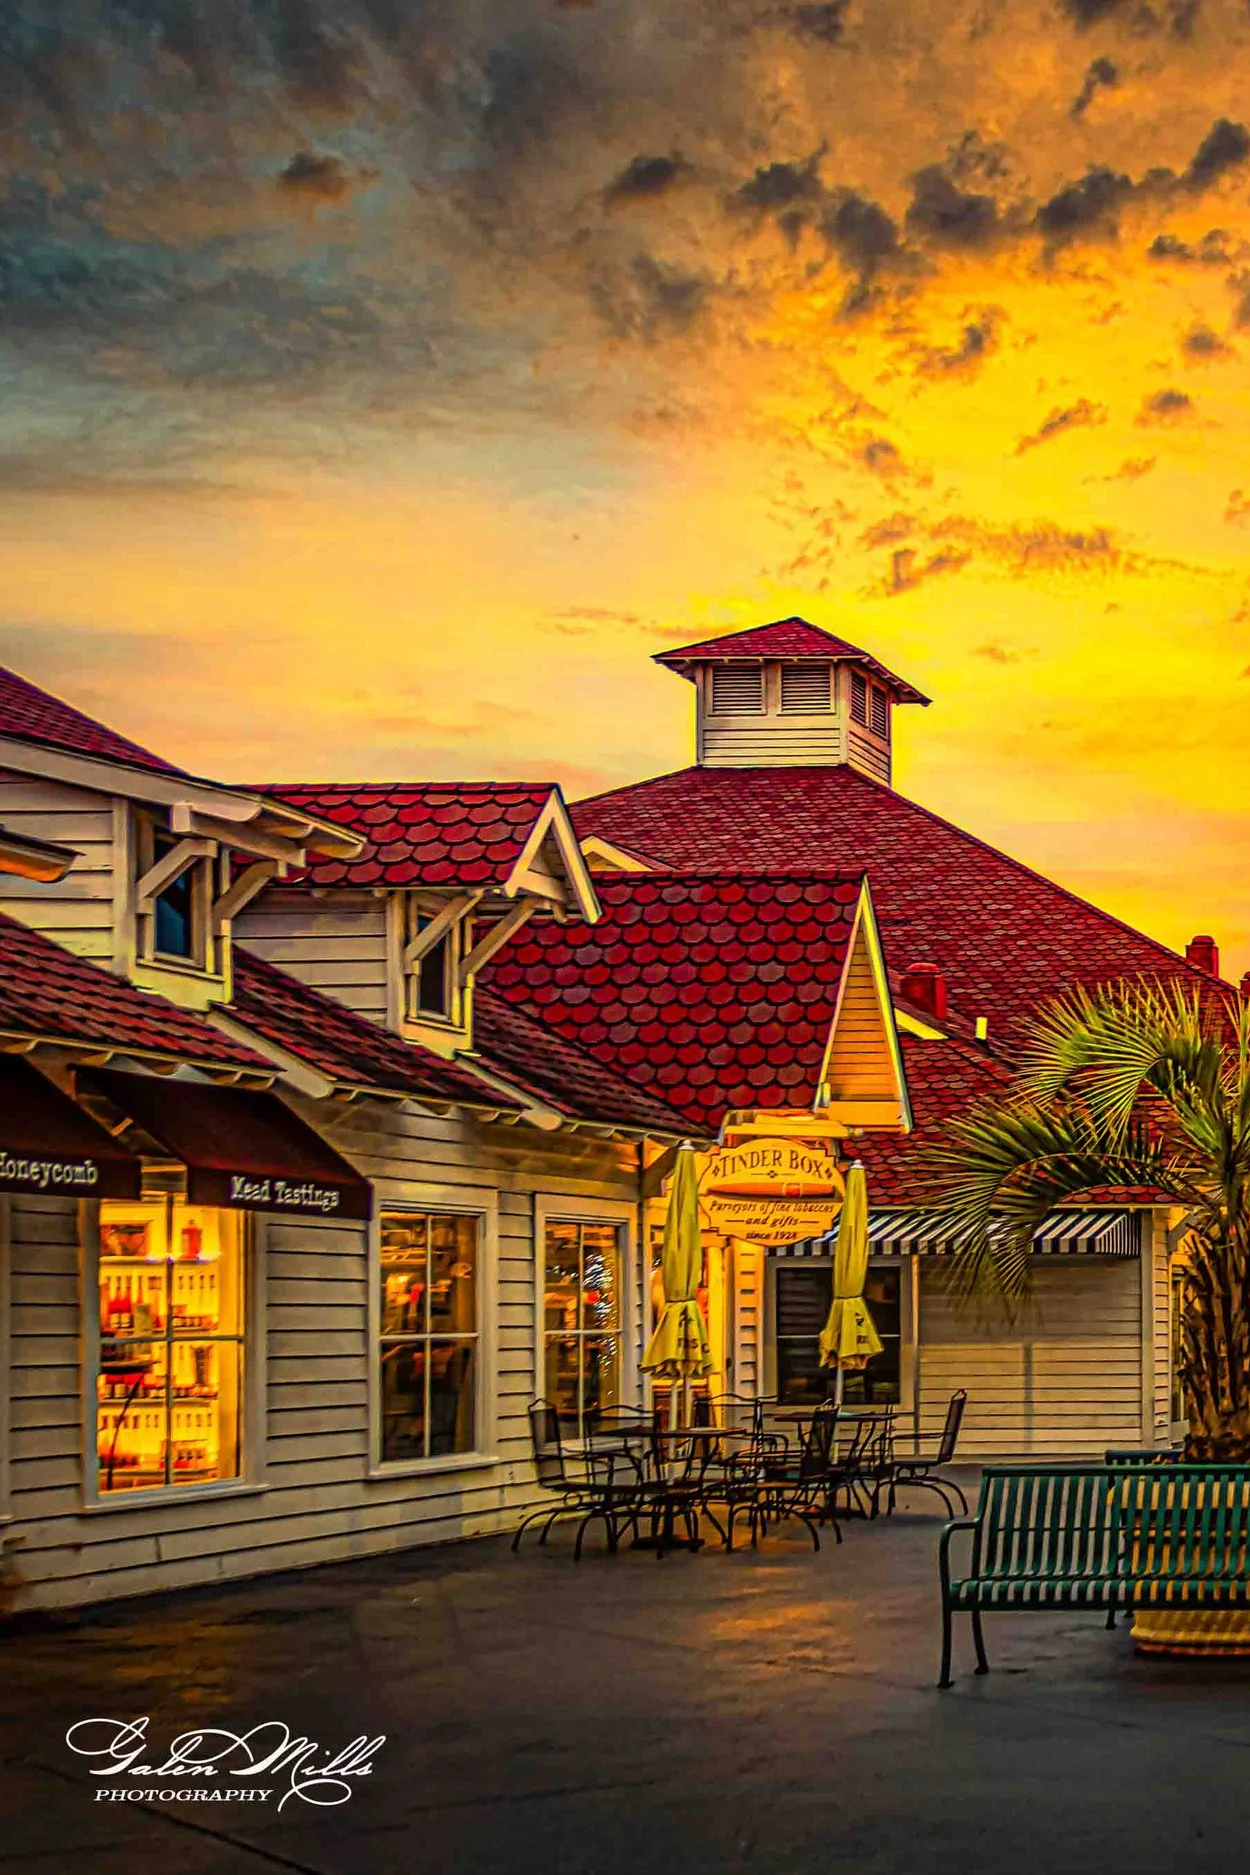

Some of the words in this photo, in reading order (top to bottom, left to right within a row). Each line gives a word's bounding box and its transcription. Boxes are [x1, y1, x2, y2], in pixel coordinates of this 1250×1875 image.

[719, 1150, 783, 1178] TINDER
[788, 1150, 824, 1179] BOX
[231, 1176, 271, 1201] Mead
[274, 1181, 340, 1212] Tastings
[759, 1203, 769, 1214] of
[770, 1201, 791, 1214] fine
[745, 1216, 769, 1226] and
[770, 1215, 799, 1227] gifts
[745, 1231, 771, 1240] since
